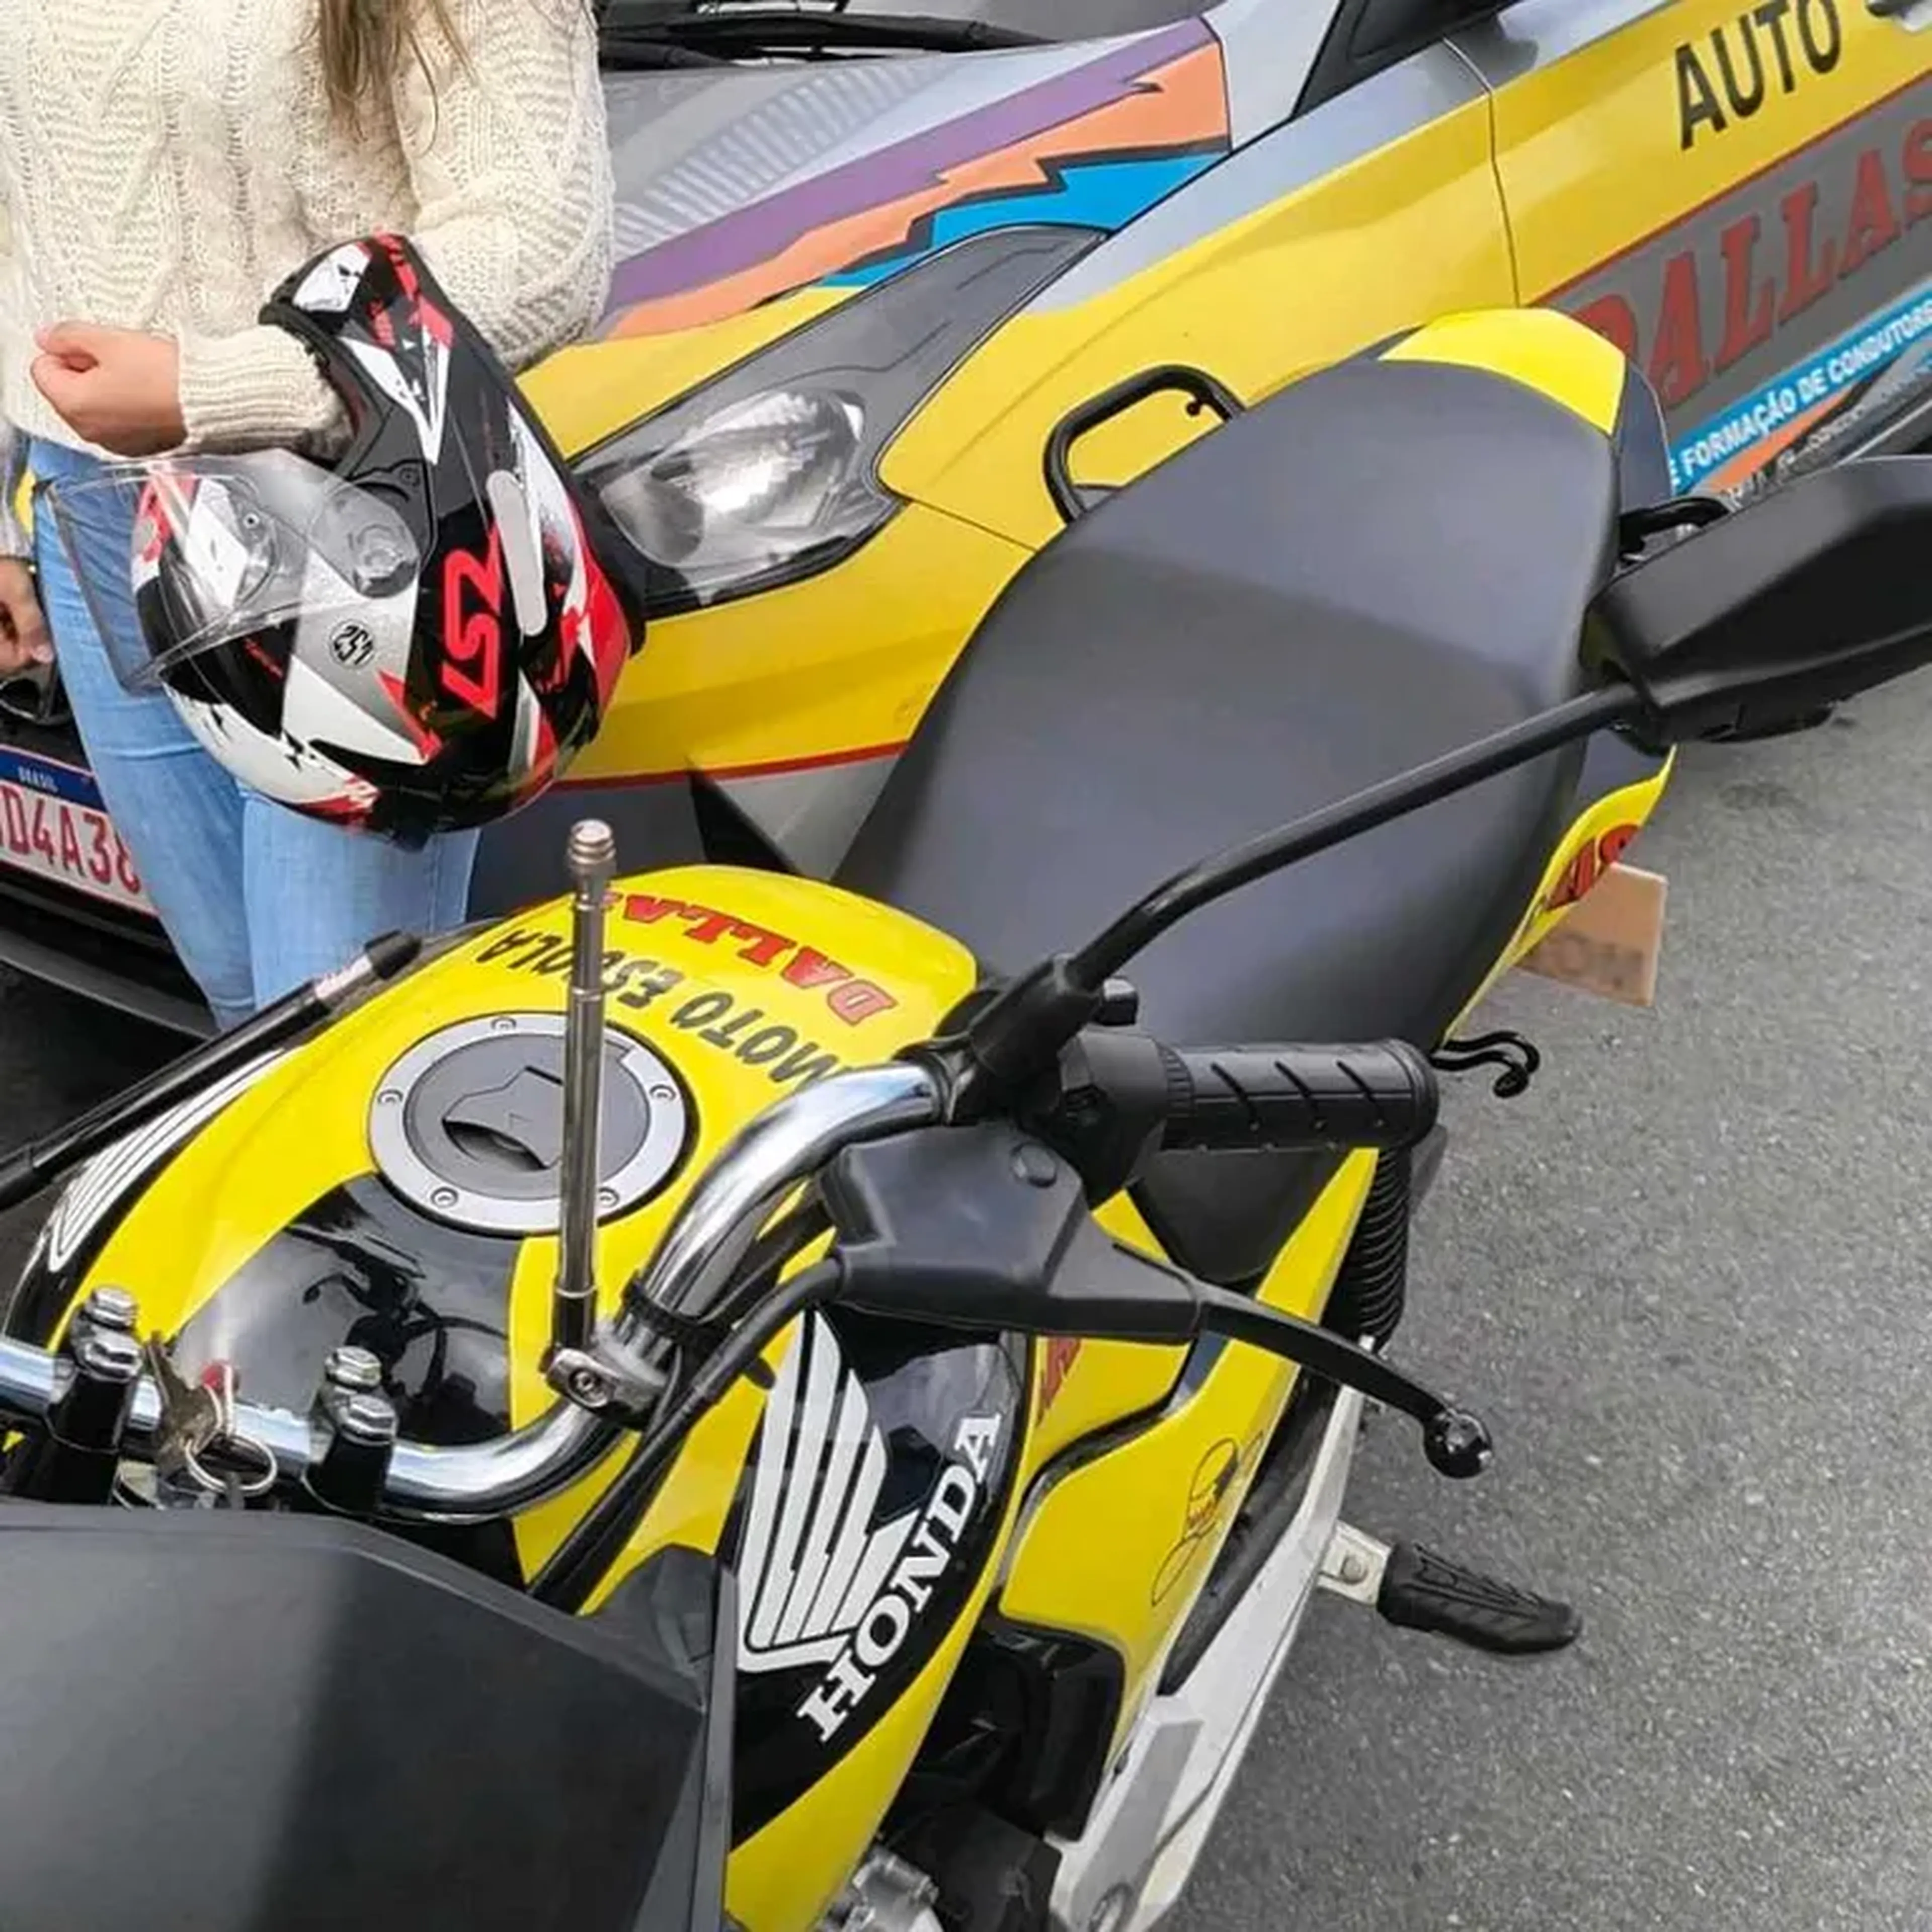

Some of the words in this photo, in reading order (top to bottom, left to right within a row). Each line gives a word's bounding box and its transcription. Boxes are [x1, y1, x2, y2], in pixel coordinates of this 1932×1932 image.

[1675, 0, 1841, 150] AUTO
[1797, 368, 1828, 404] DE
[602, 889, 897, 1025] DALLA
[670, 992, 839, 1090] MOTO
[797, 1413, 1003, 1742] HONDA
